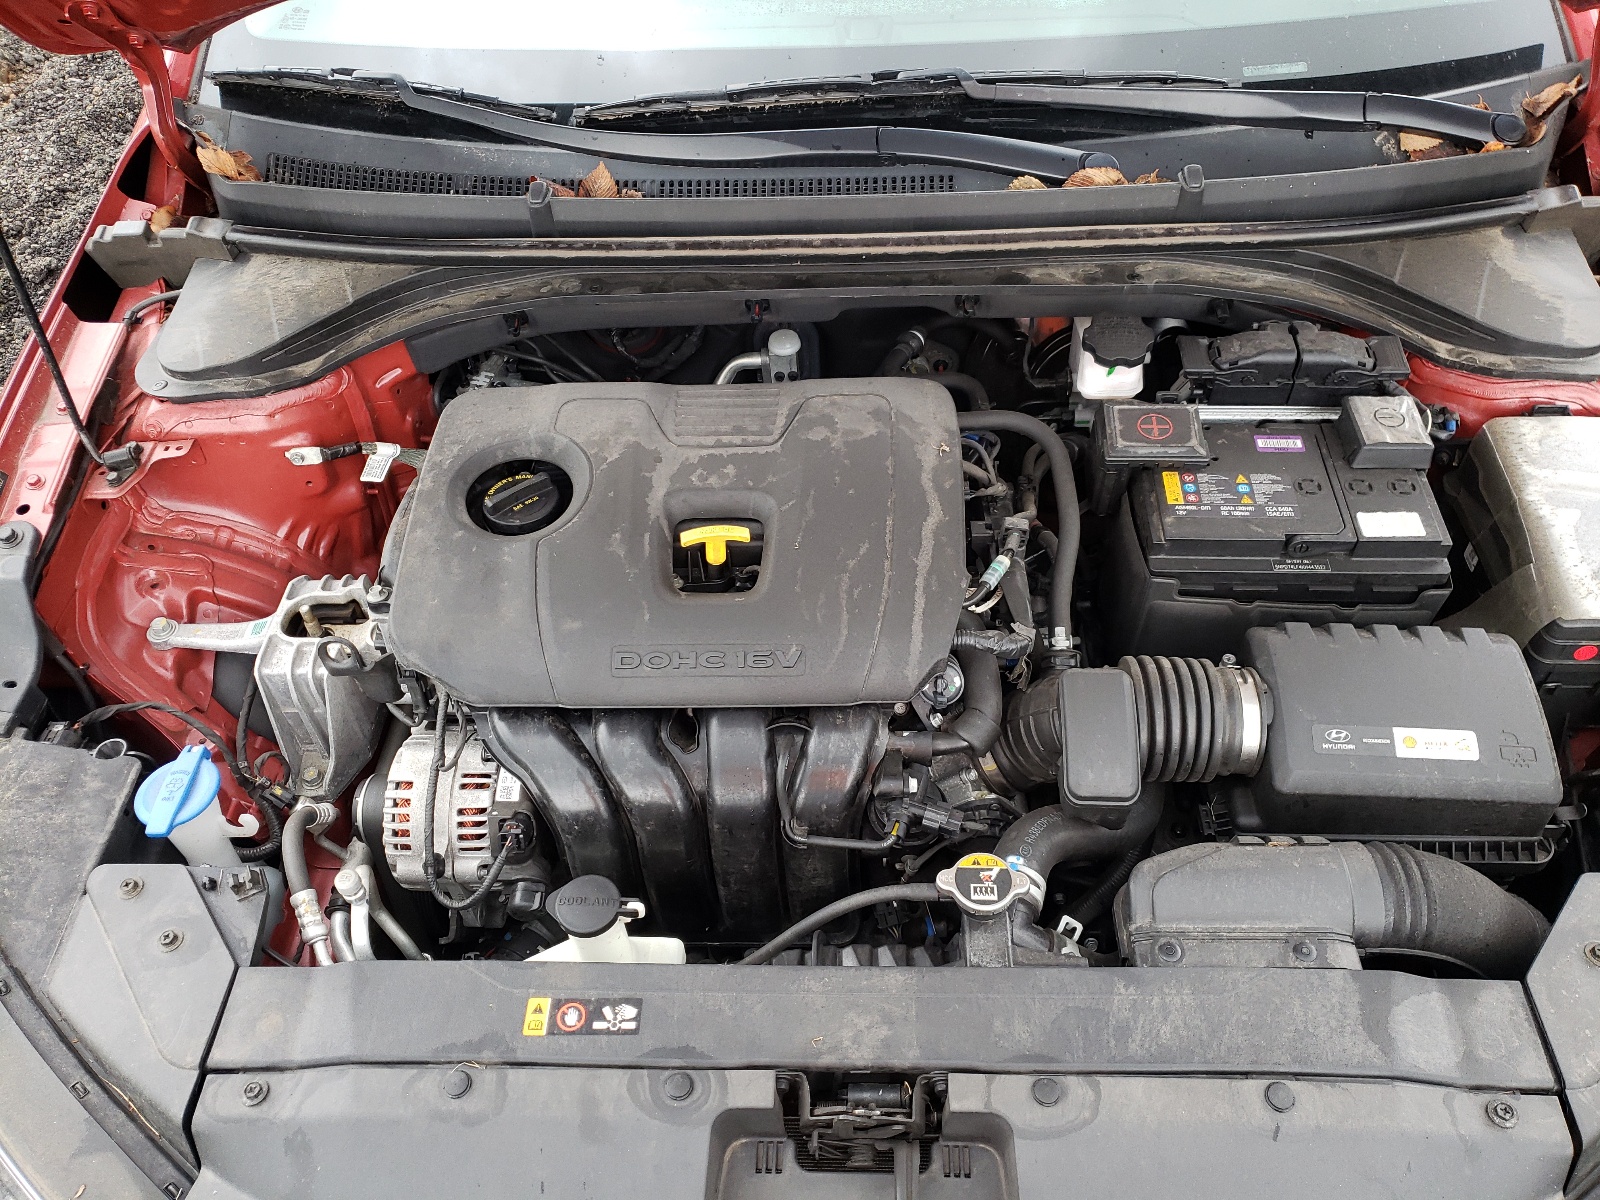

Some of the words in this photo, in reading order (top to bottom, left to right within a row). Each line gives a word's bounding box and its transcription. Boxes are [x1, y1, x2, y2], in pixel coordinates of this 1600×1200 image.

[614, 651, 726, 670] DOHC
[736, 650, 803, 669] 16V
[1322, 743, 1356, 751] HYUNDAI
[558, 896, 619, 908] COOLANT
